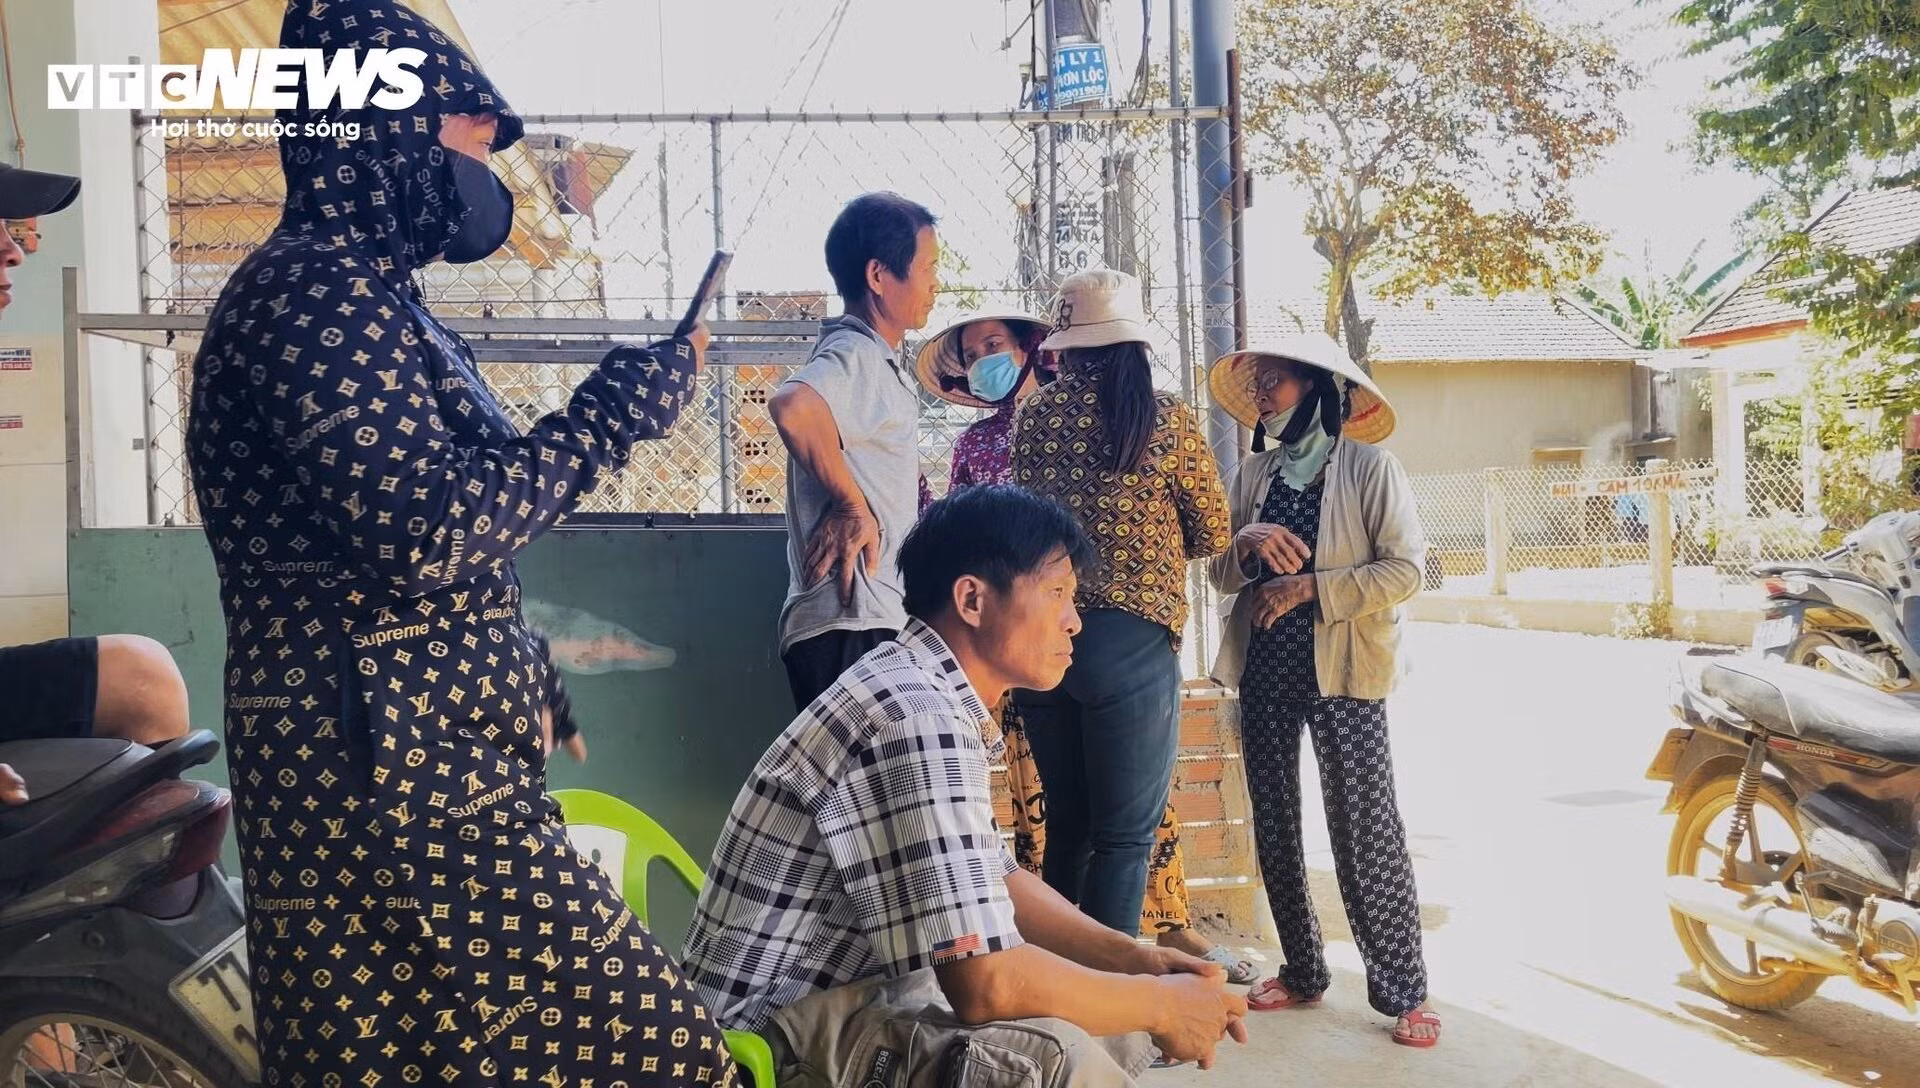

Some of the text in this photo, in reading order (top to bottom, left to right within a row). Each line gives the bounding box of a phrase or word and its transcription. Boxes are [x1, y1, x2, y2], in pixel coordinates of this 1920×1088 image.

[262, 560, 334, 574] Suprem
[440, 528, 466, 585] upreme
[351, 622, 430, 649] Supreme
[229, 692, 292, 712] Supreme
[447, 782, 515, 818] Supreme
[254, 893, 316, 914] Supreme
[1141, 910, 1181, 920] HANEL
